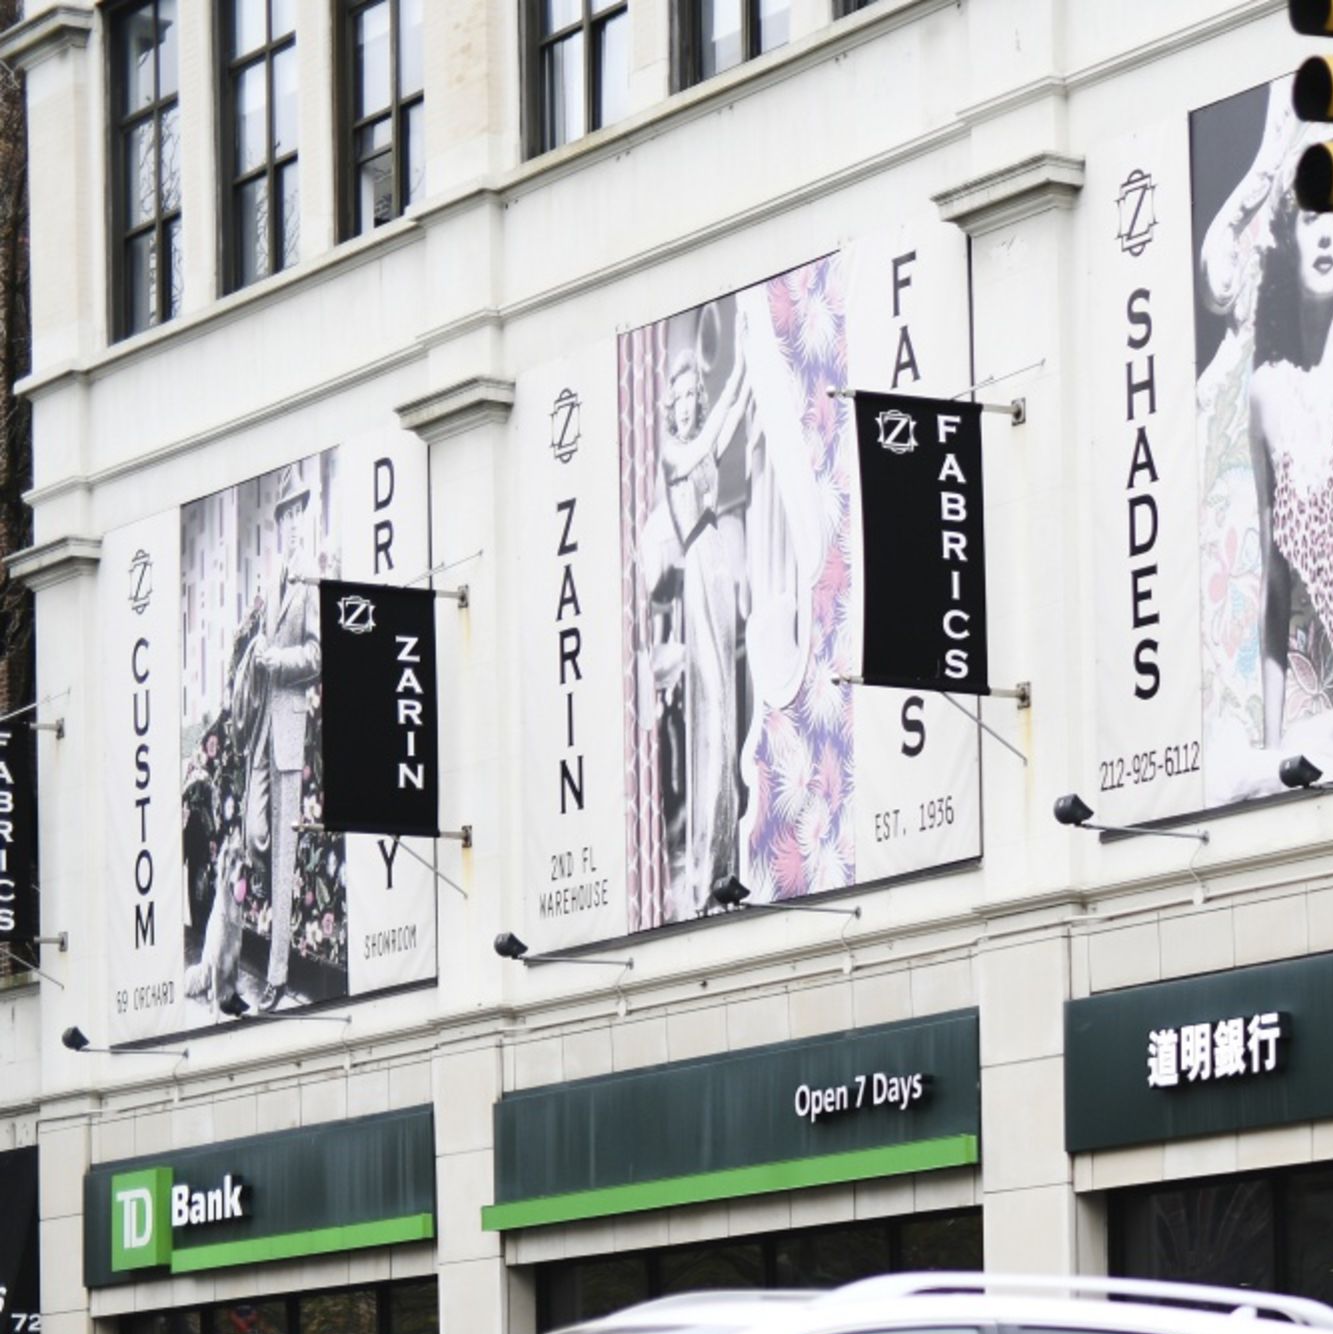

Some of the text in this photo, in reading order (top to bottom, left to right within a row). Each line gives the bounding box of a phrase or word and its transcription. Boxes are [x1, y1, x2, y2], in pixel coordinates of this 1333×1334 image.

[1125, 288, 1161, 701] SHADES
[937, 414, 969, 680] FABRICS
[555, 498, 585, 815] ZARIN
[395, 636, 424, 790] ZARIN
[131, 637, 155, 949] CUSTOM
[1099, 740, 1200, 791] 212-925-6112
[919, 795, 954, 832] 1936
[539, 878, 608, 918] WAREHOUSE
[551, 845, 597, 881] 2ND FL
[1147, 1012, 1282, 1091] 道明銀行
[794, 1070, 923, 1122] Open 7 Days
[115, 1174, 243, 1249] TD Bank
[11, 1312, 41, 1332] 72
